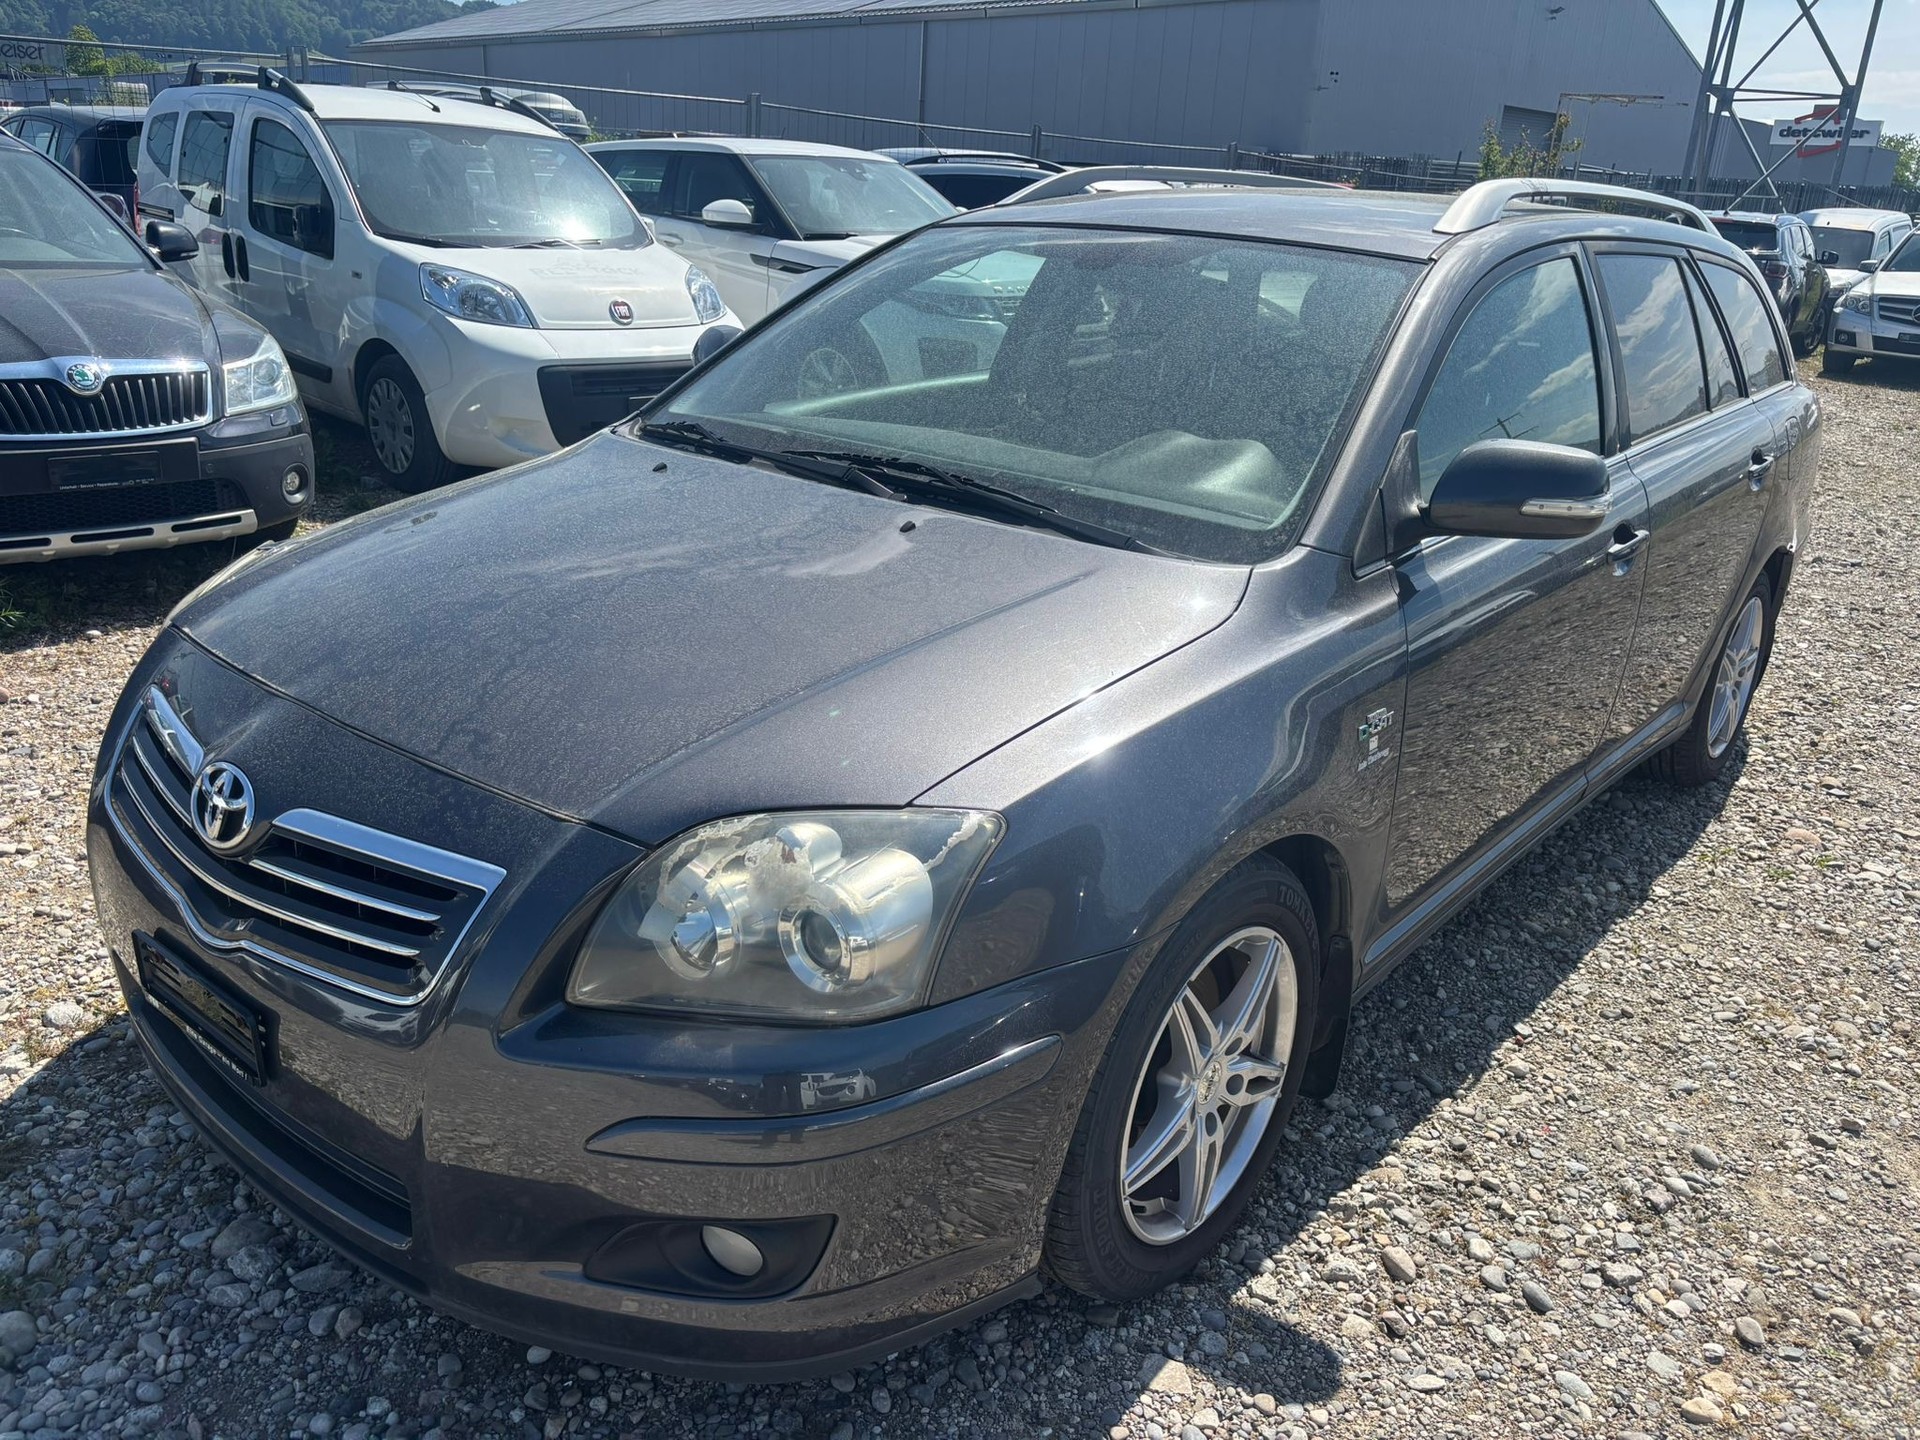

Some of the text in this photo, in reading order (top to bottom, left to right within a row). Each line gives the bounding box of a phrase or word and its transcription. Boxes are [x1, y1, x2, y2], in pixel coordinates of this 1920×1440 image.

[0, 42, 44, 60] eiser
[1779, 126, 1870, 138] detwier
[615, 305, 630, 317] FIAT
